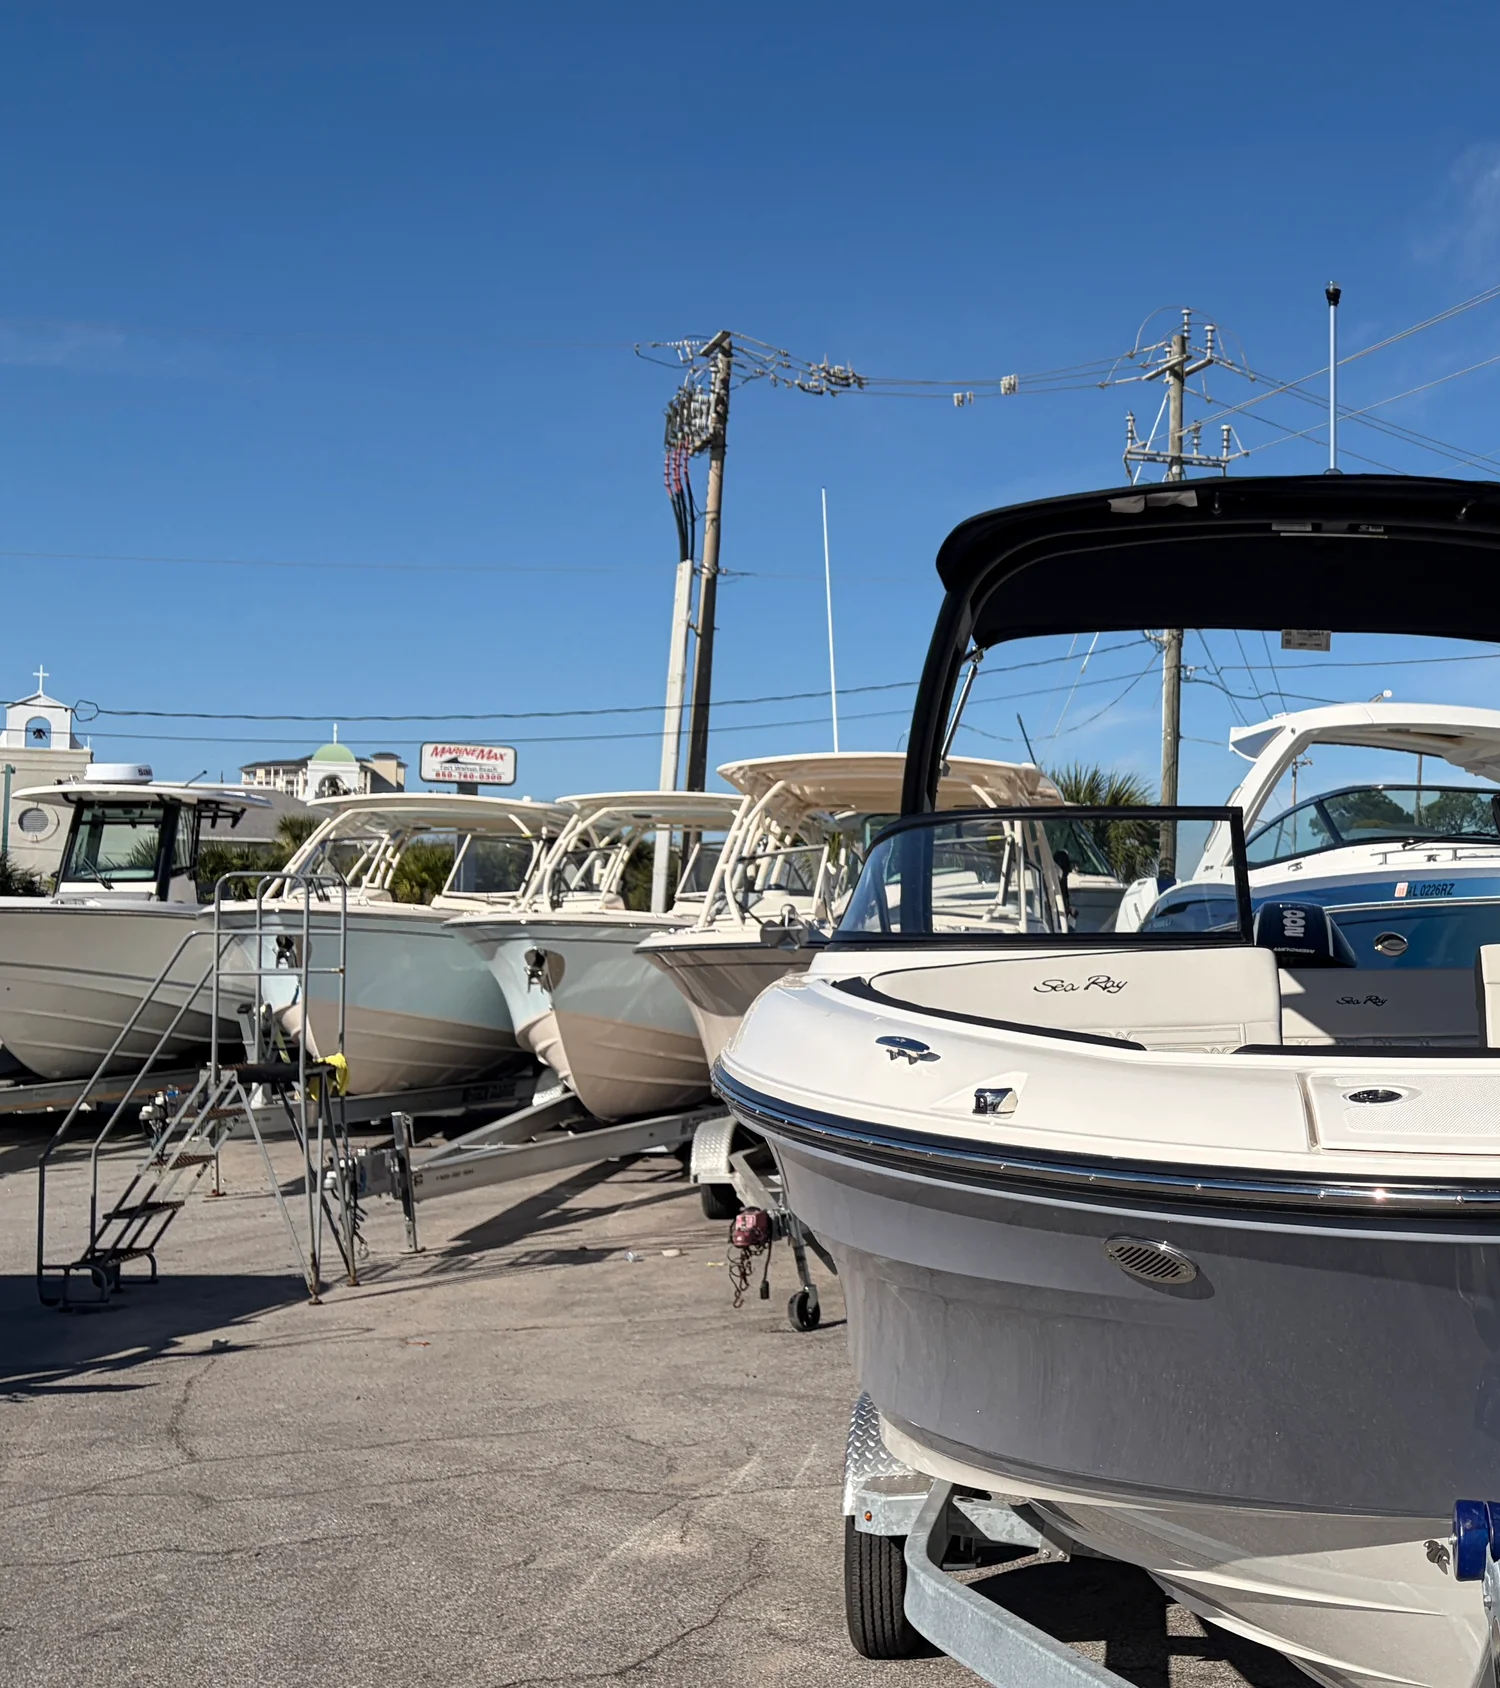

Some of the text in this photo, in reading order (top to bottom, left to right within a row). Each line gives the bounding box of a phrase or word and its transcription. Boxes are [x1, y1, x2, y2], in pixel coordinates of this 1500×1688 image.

[1420, 883, 1455, 896] 0226RZ
[1282, 910, 1306, 937] 200
[1033, 975, 1128, 993] Sea Ray
[1336, 995, 1388, 1007] Sea Ray
